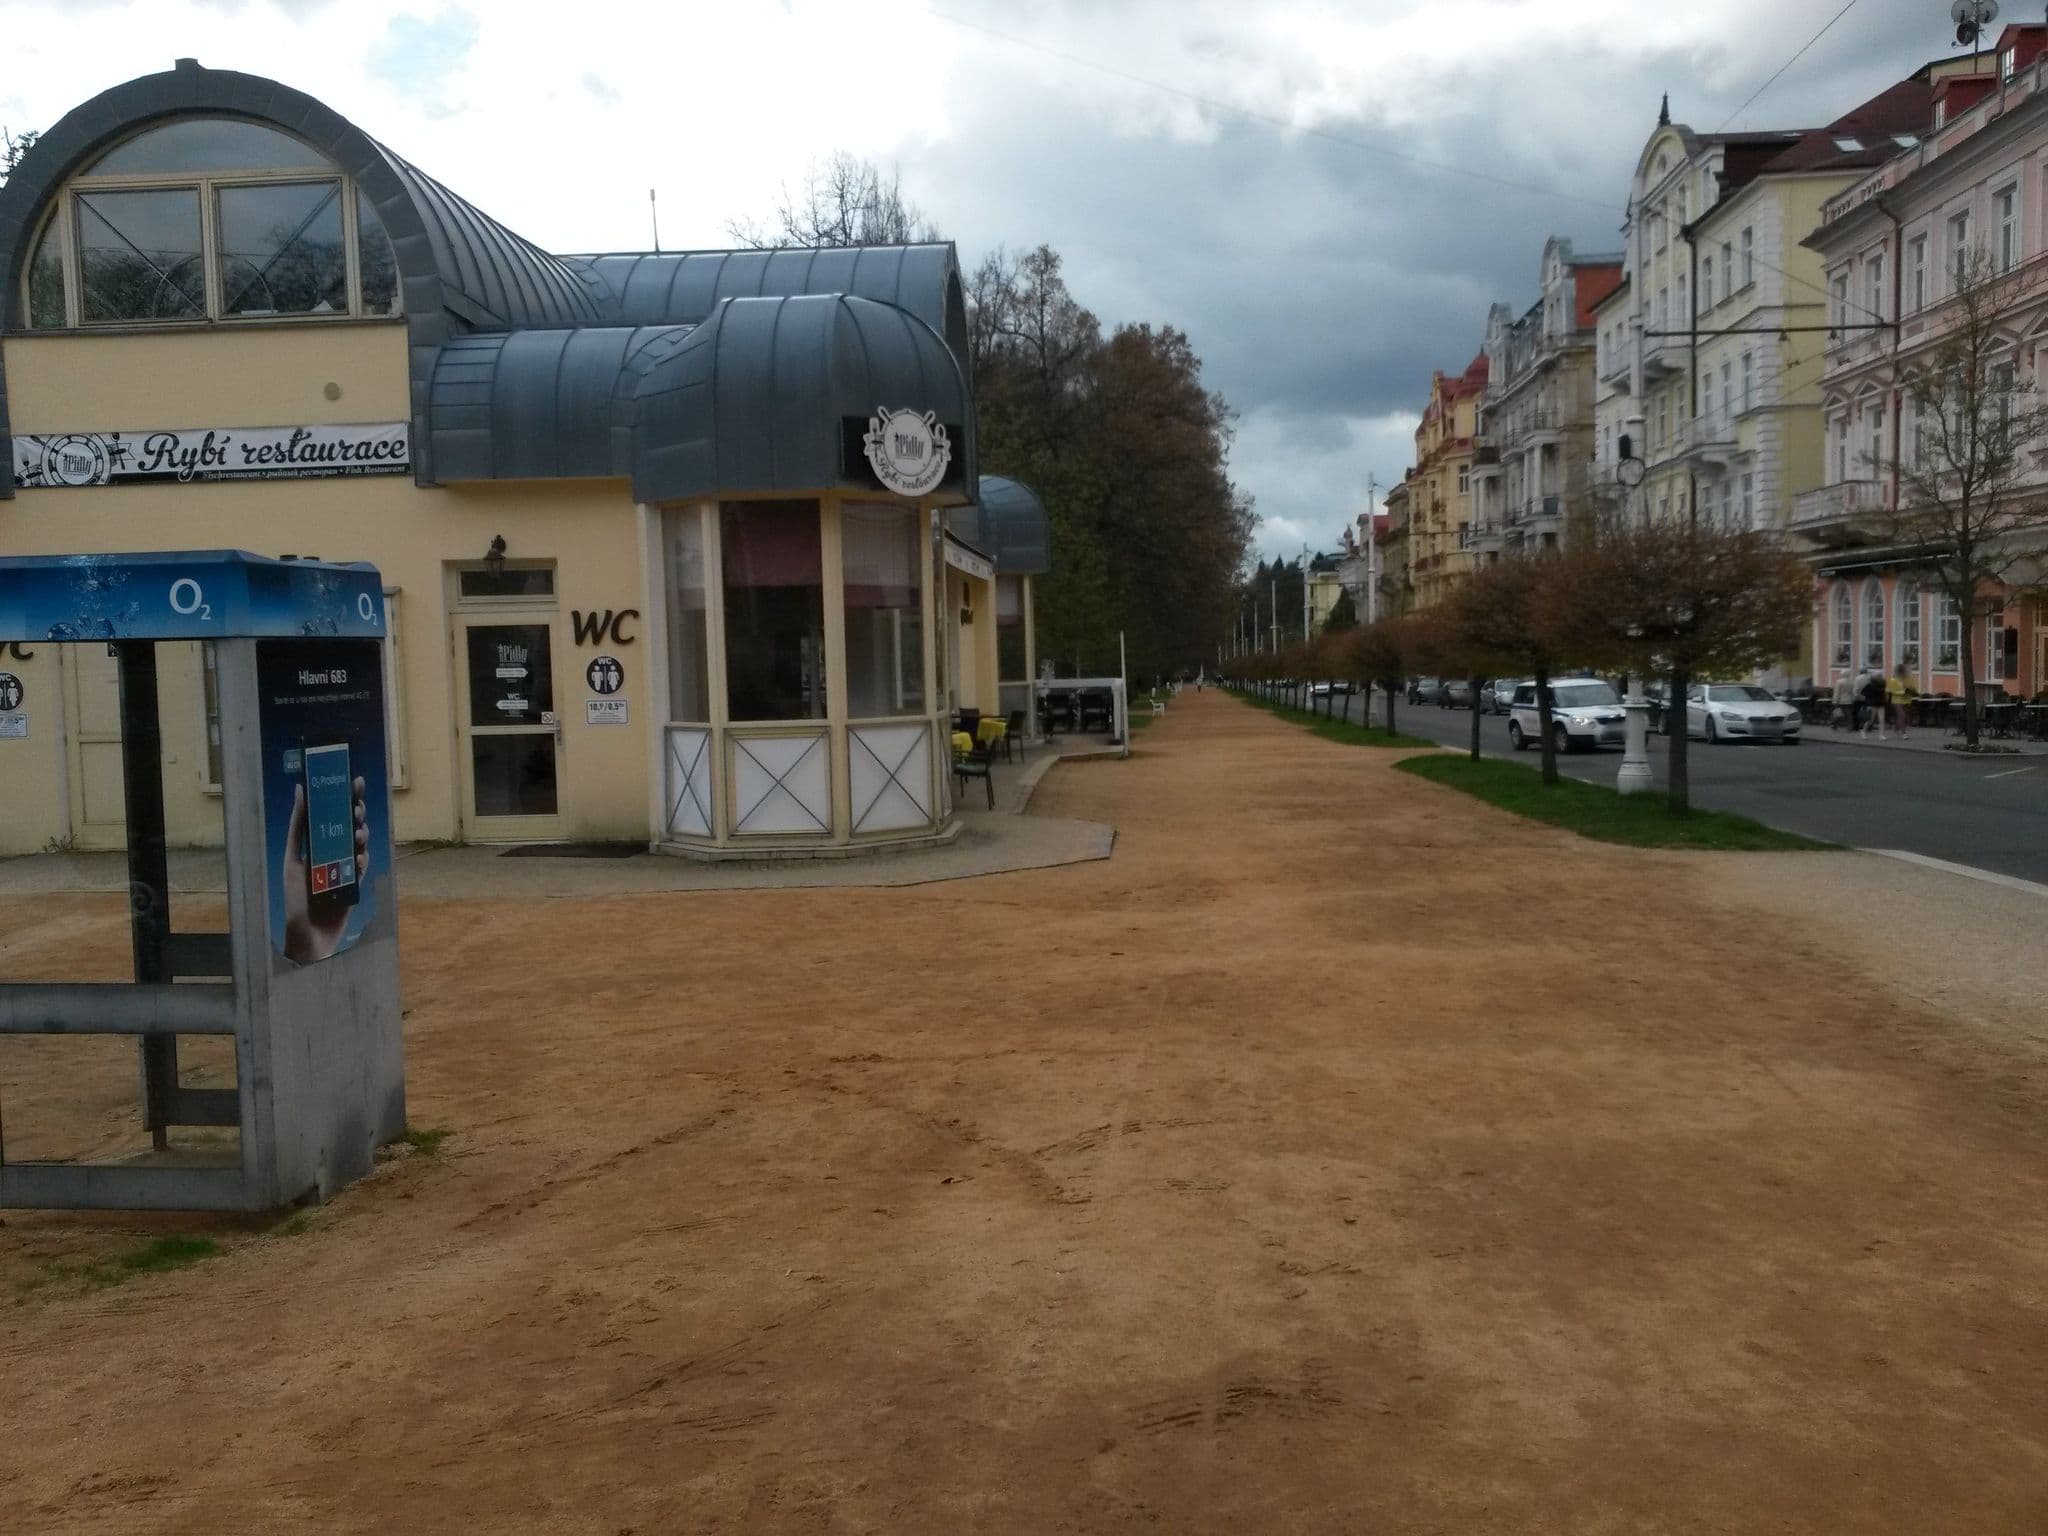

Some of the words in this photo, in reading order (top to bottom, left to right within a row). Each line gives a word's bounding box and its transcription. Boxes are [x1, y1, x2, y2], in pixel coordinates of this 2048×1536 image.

[137, 431, 230, 481] Rybí
[241, 428, 407, 464] restaurace
[571, 610, 640, 646] WC
[597, 657, 612, 665] WC
[299, 670, 328, 685] Hlavní
[330, 669, 347, 684] 683
[507, 692, 520, 700] WC
[328, 822, 344, 840] km
